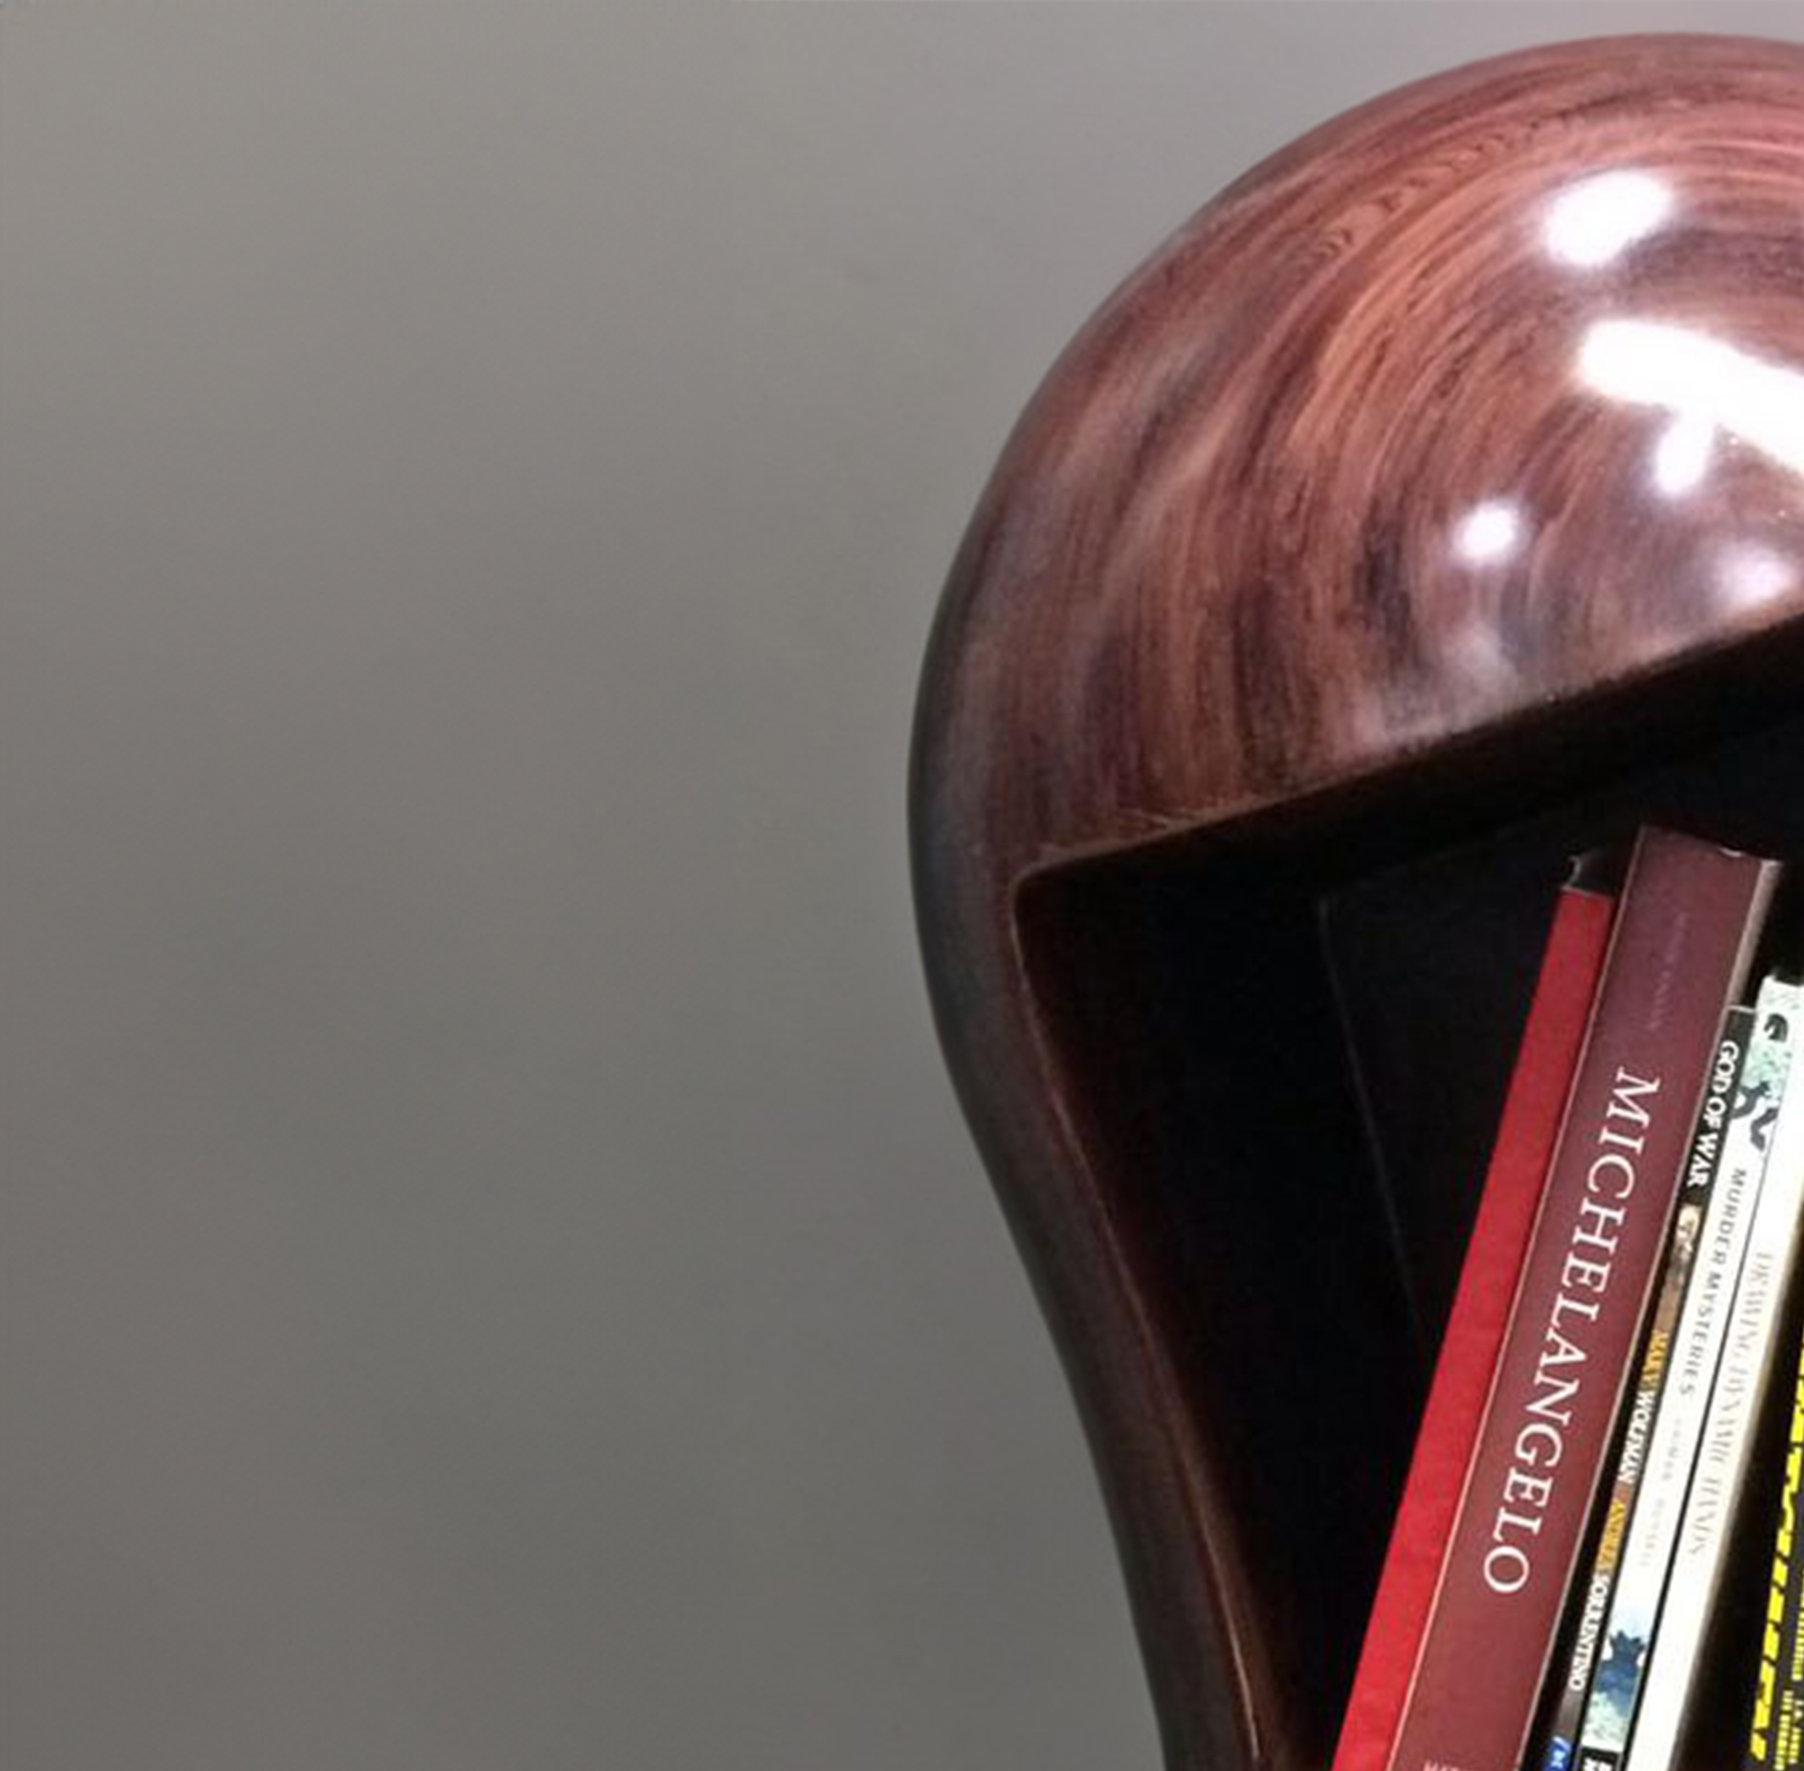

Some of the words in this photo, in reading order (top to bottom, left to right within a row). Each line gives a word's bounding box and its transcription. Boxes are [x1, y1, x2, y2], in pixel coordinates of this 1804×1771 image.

[1701, 1094, 1727, 1128] OF
[1710, 1039, 1741, 1093] GOD
[1686, 1129, 1719, 1189] WAR
[1709, 1168, 1747, 1265] MURDER
[1476, 1064, 1660, 1597] MICHELANGELO
[1678, 1270, 1723, 1397] MYSTERIES
[1730, 1250, 1774, 1360] DRAWING
[1614, 1387, 1657, 1485] WOLFMAN
[1706, 1365, 1748, 1467] DYNAMIC
[1686, 1476, 1723, 1557] HANDS
[1565, 1573, 1612, 1692] SORRENTINO
[1550, 1749, 1565, 1770] DC
